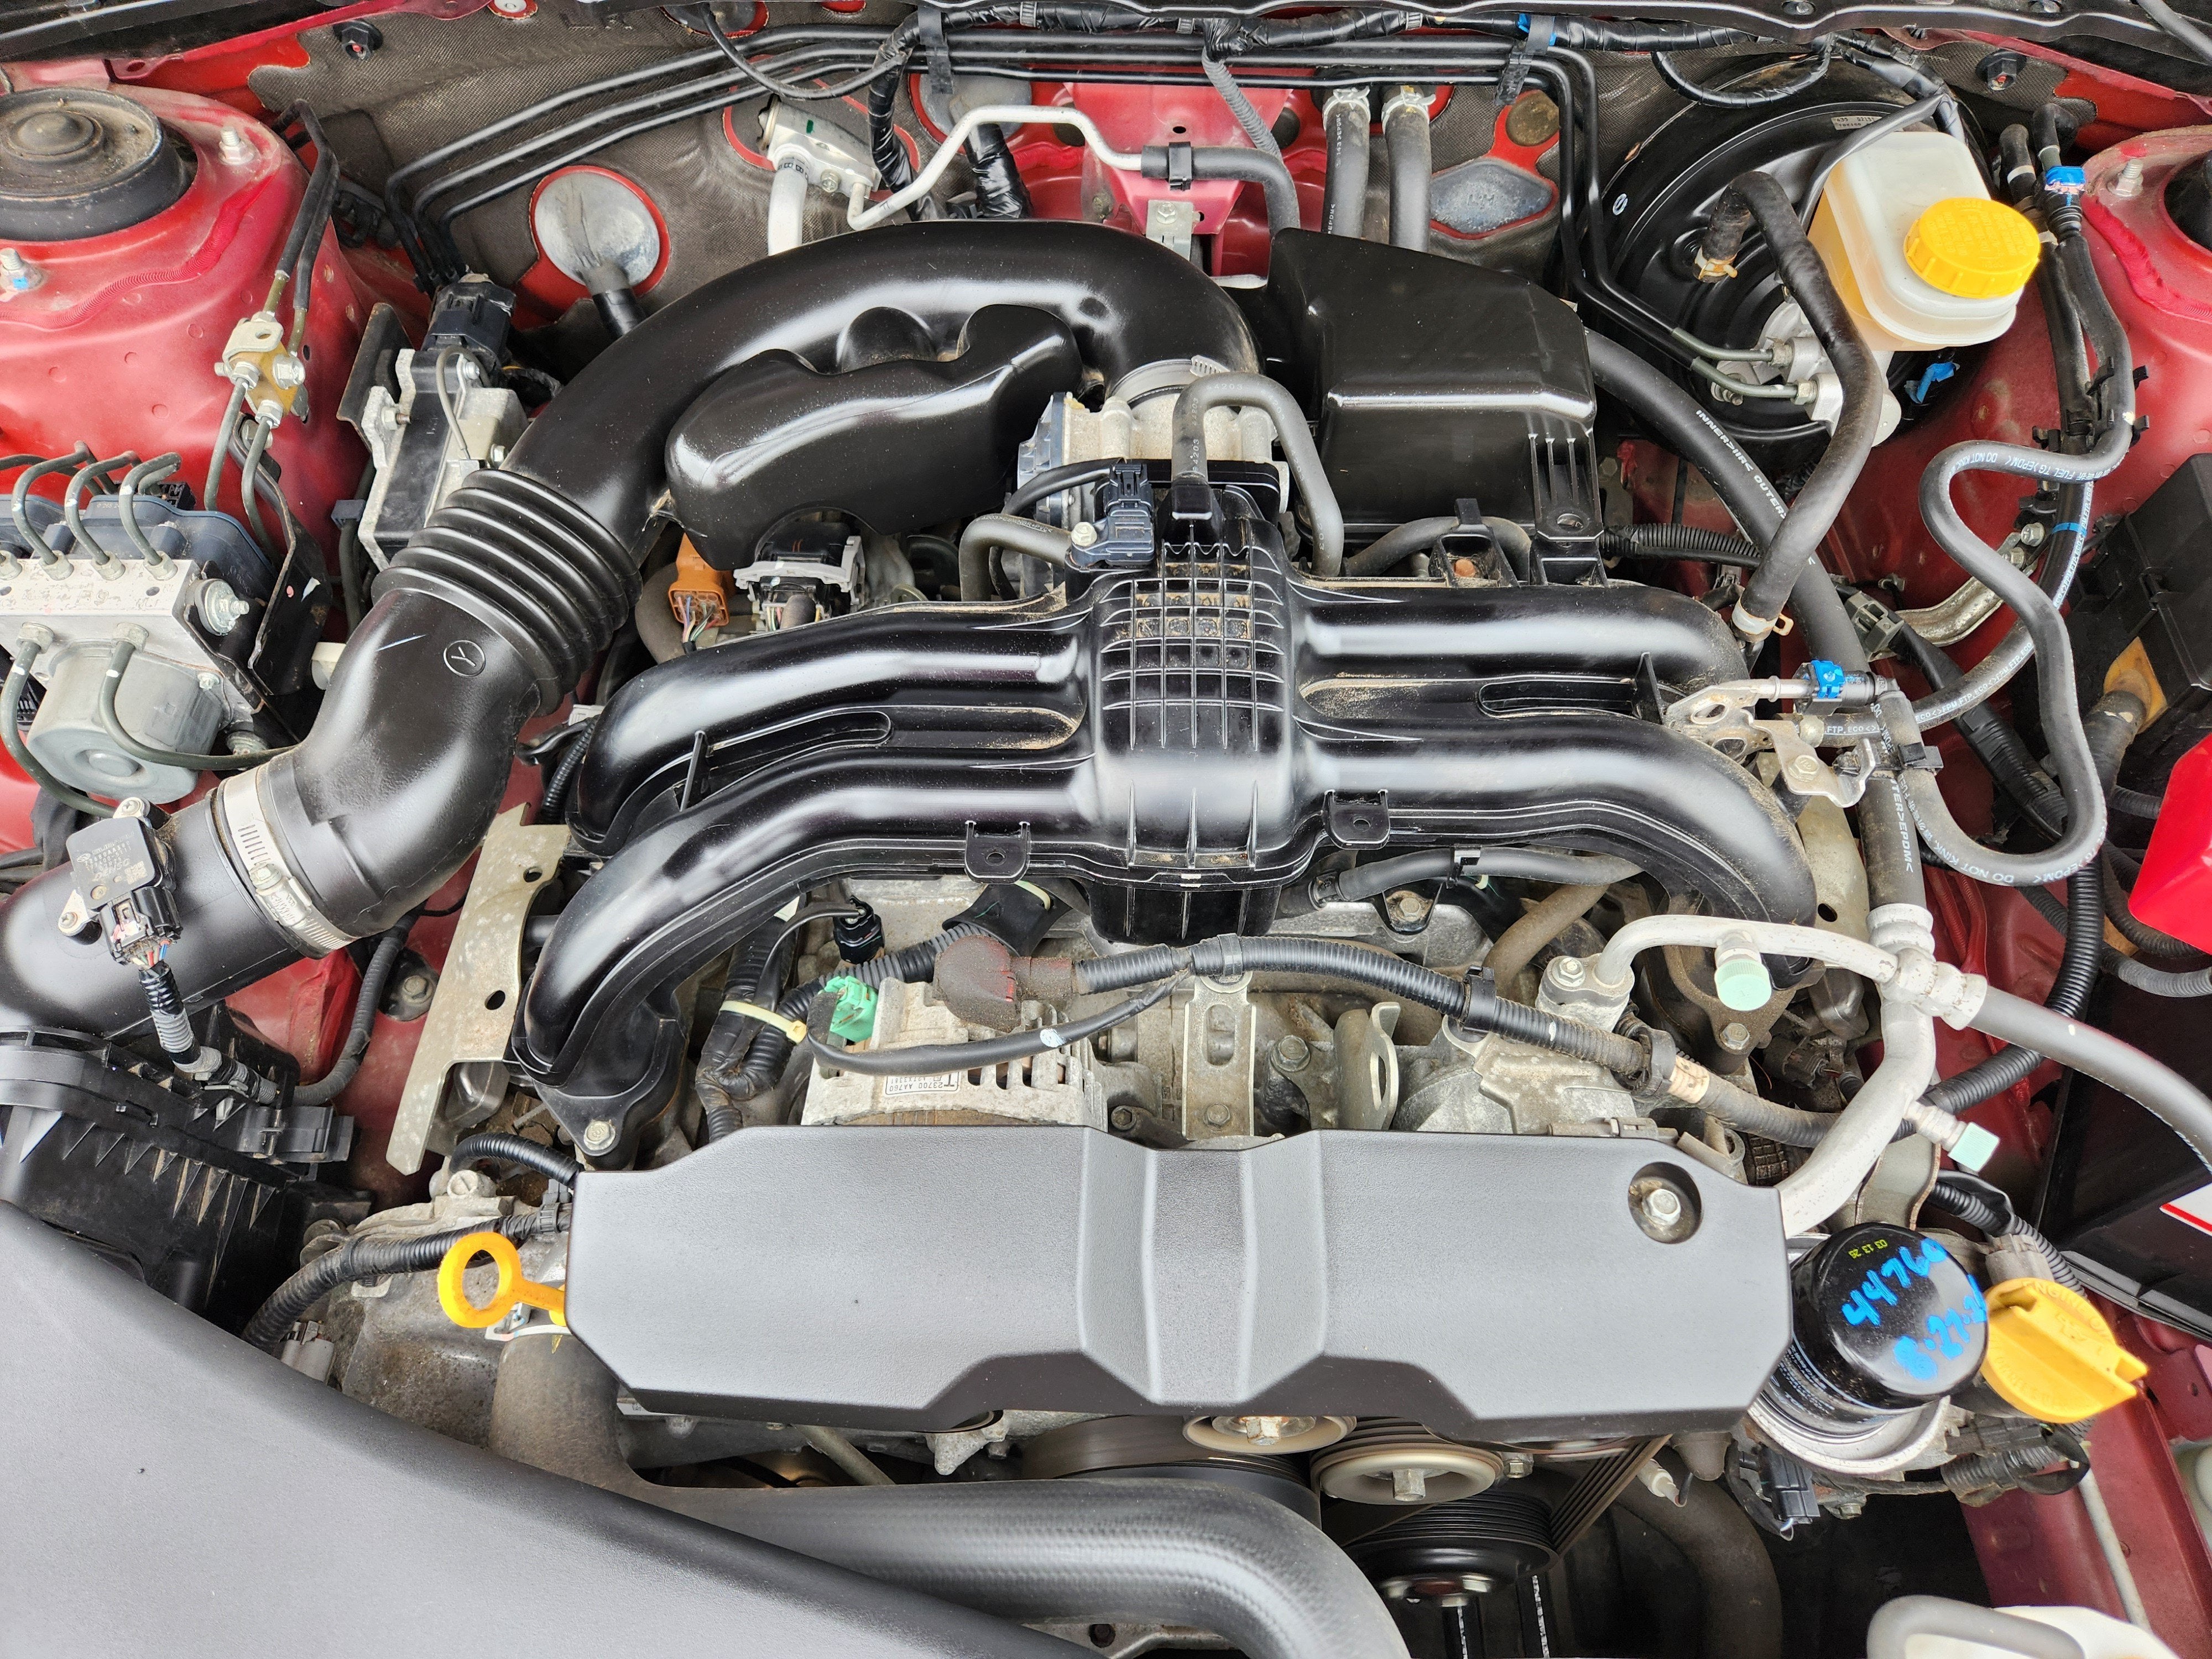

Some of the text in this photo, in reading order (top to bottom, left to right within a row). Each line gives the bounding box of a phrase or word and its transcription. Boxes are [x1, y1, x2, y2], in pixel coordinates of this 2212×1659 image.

[1972, 452, 1985, 463] NOT
[1986, 452, 1999, 463] DO
[1961, 863, 1990, 879] NOT
[1992, 873, 2015, 883] DO
[889, 1083, 913, 1092] AA760
[1861, 1244, 1874, 1254] 13
[1874, 1239, 1888, 1250] 03
[1841, 1237, 1948, 1326] 44760
